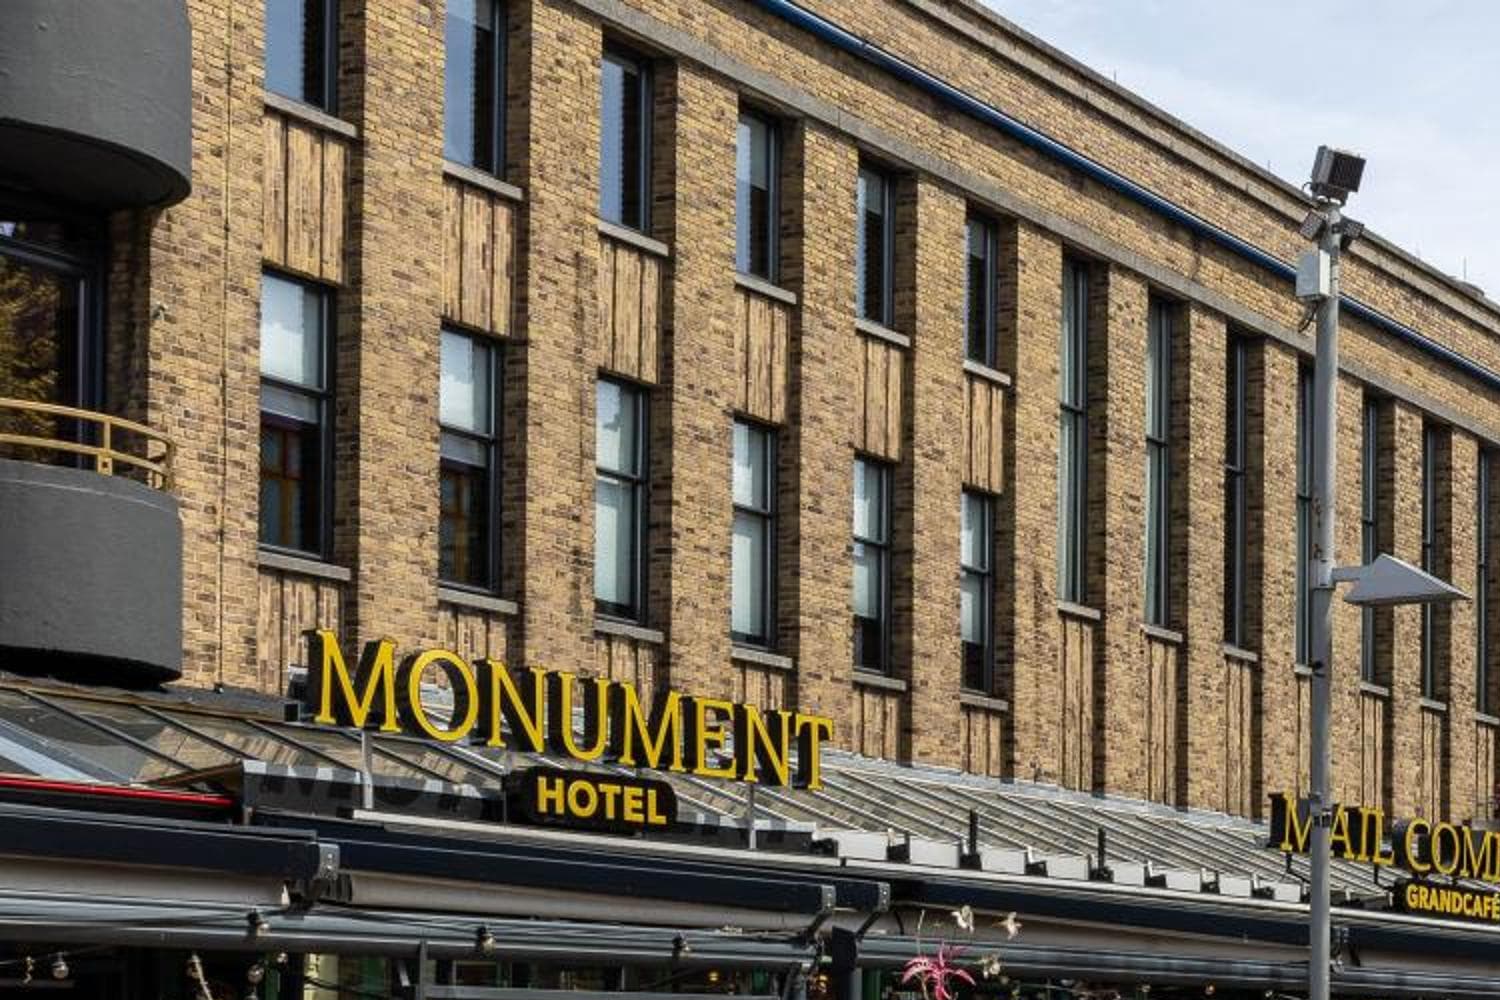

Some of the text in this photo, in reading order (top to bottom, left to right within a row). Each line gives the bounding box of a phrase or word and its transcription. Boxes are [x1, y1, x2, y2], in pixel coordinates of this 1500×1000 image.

[312, 629, 834, 790] MONUMENT
[536, 776, 668, 826] HOTEL
[1280, 788, 1395, 866] MAIL
